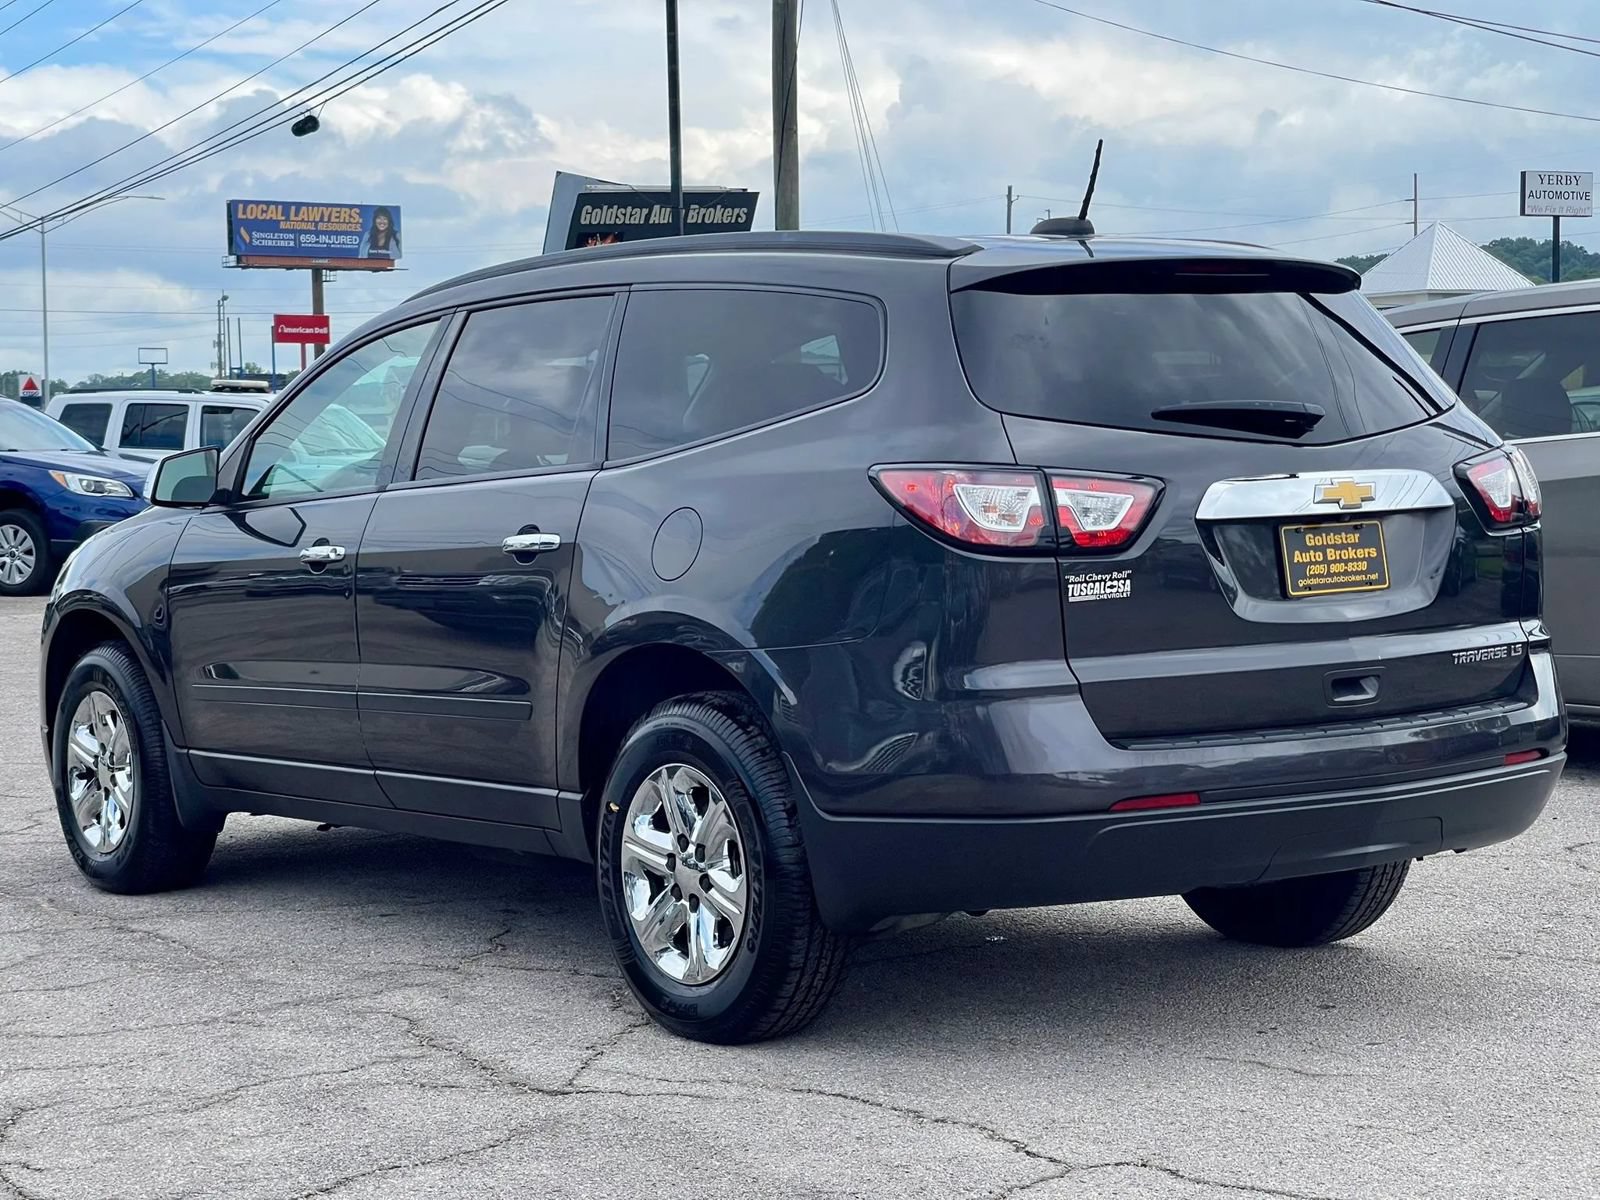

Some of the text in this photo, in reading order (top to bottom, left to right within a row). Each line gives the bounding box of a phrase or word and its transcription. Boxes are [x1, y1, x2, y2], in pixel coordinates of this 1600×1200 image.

[1538, 174, 1581, 186] YERBY
[1528, 190, 1591, 201] AUTOMOTIVE
[237, 203, 363, 223] LOCAL LAWYERS.
[580, 204, 748, 225] Goldstar Au Brokers
[280, 221, 362, 232] NATIONAL RESOURCES.
[252, 231, 295, 240] SINGLETON
[300, 233, 359, 245] 659-INJURED
[1305, 532, 1360, 546] Goldstar
[1293, 547, 1377, 563] Auto Brokers
[1306, 564, 1328, 576] (205)
[1086, 573, 1111, 581] Chevy
[1297, 573, 1379, 587] goldstarautobrokers.net
[1096, 592, 1131, 600] CHEVROLET
[1452, 644, 1522, 665] TRAVERSE LS
